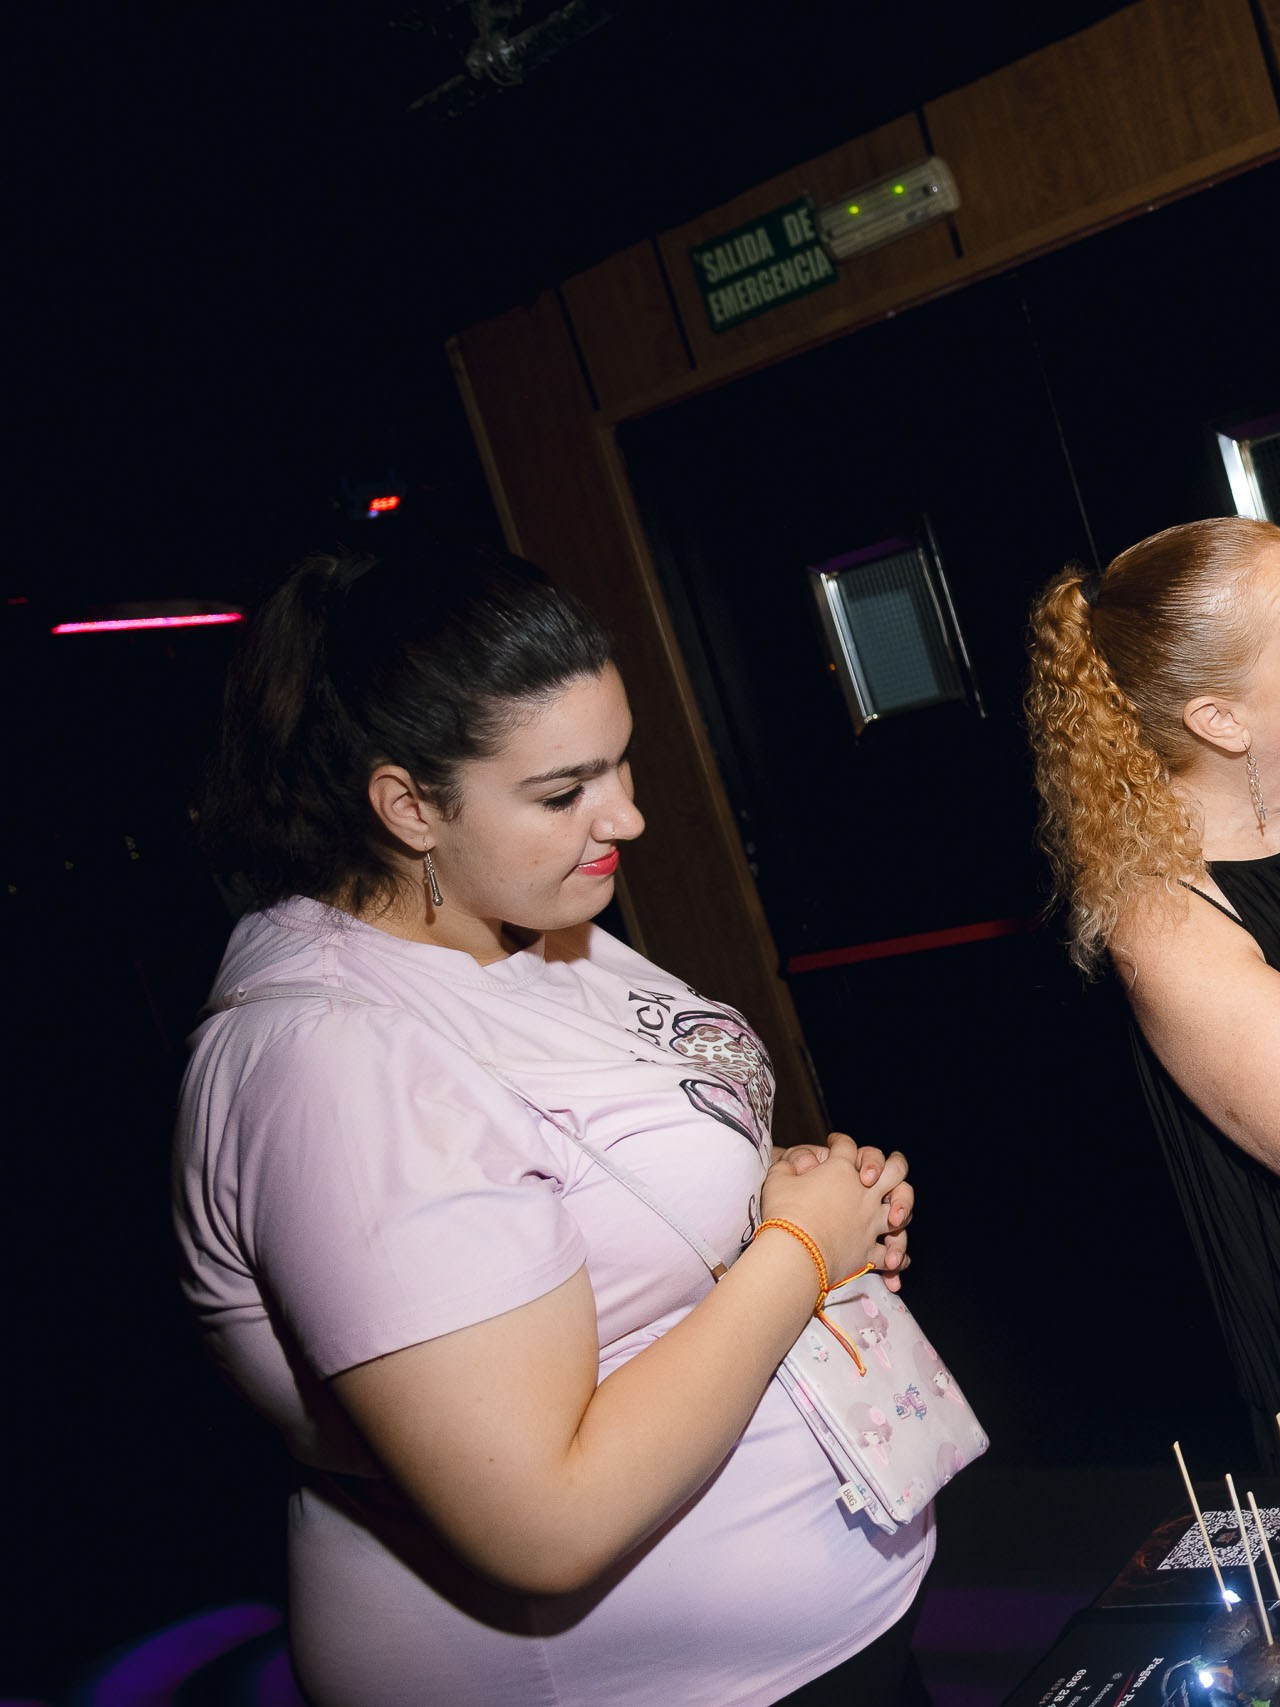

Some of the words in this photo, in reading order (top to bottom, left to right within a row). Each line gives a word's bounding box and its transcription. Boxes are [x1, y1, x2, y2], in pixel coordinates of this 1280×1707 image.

[702, 226, 776, 283] SALIDA
[783, 207, 816, 248] DE
[708, 245, 834, 323] EMERGENCIA
[1133, 1657, 1164, 1688] Pagos
